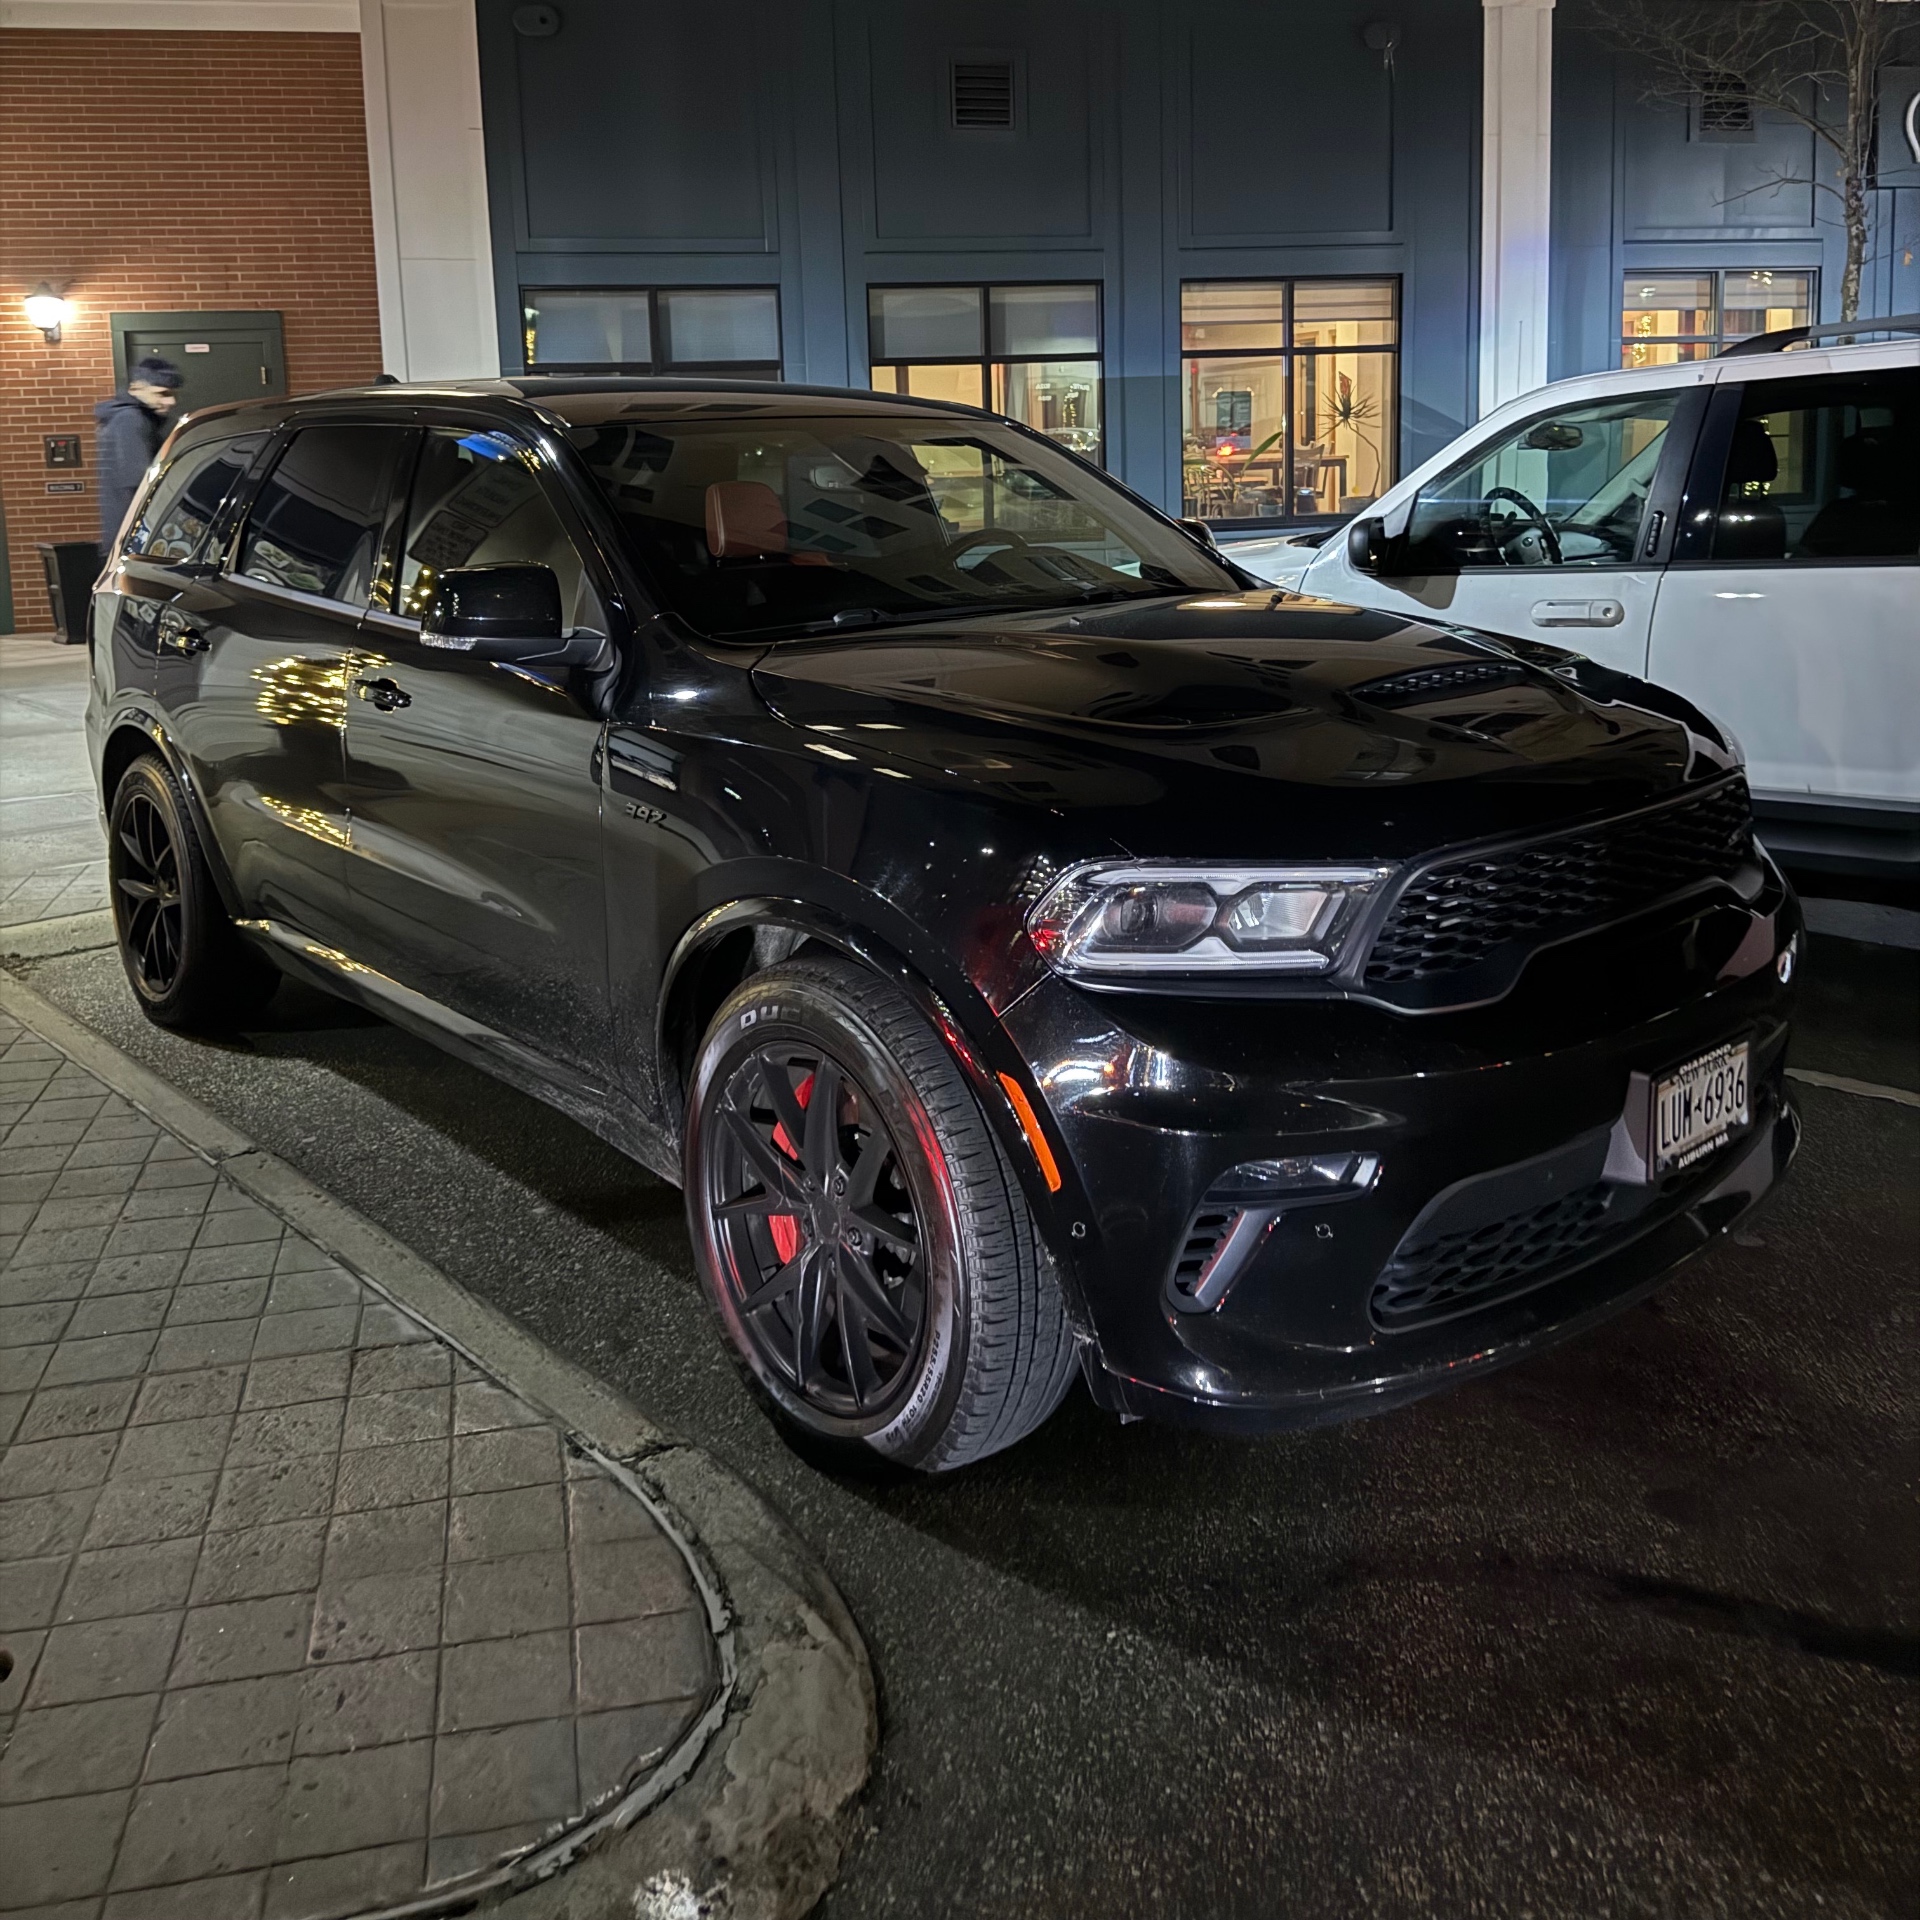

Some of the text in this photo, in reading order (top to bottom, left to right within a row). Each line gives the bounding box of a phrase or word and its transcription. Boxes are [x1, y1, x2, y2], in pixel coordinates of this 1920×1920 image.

[625, 802, 663, 823] 392
[1679, 1043, 1732, 1074] DIAMOND
[1677, 1067, 1700, 1089] NEW
[1703, 1060, 1745, 1125] 6936
[1677, 1139, 1714, 1170] AUBURN
[1715, 1132, 1729, 1148] MA
